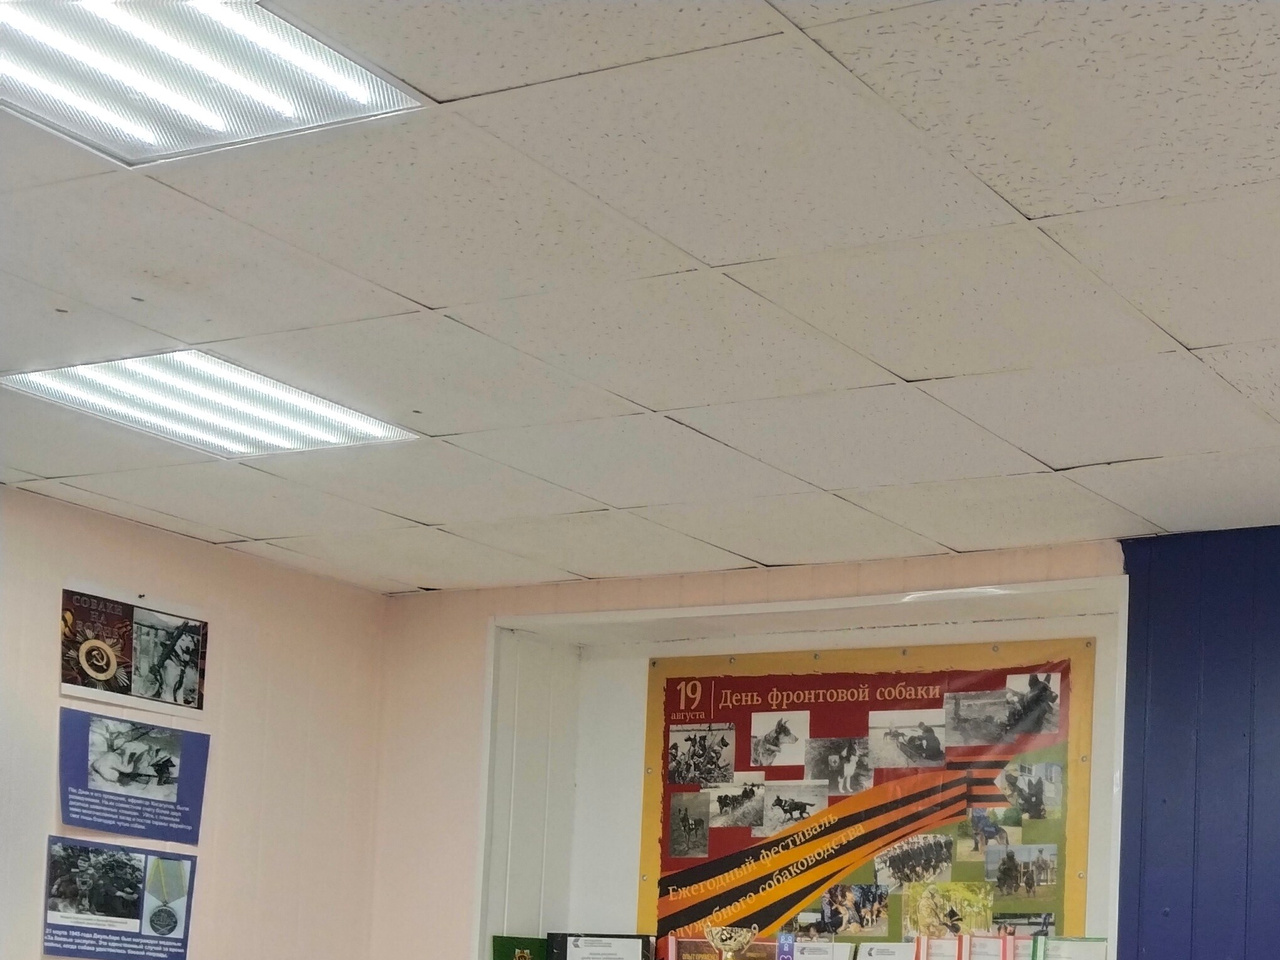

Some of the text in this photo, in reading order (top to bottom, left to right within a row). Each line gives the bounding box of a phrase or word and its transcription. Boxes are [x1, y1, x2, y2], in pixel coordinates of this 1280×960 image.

[72, 595, 123, 616] СОБАКИ
[90, 611, 107, 624] НА
[677, 680, 703, 710] 19
[719, 682, 941, 709] День фронтовой собаки
[670, 711, 705, 721] августа
[667, 813, 840, 901] Ежегодный фестиваль
[668, 823, 866, 938] служебного собаководства
